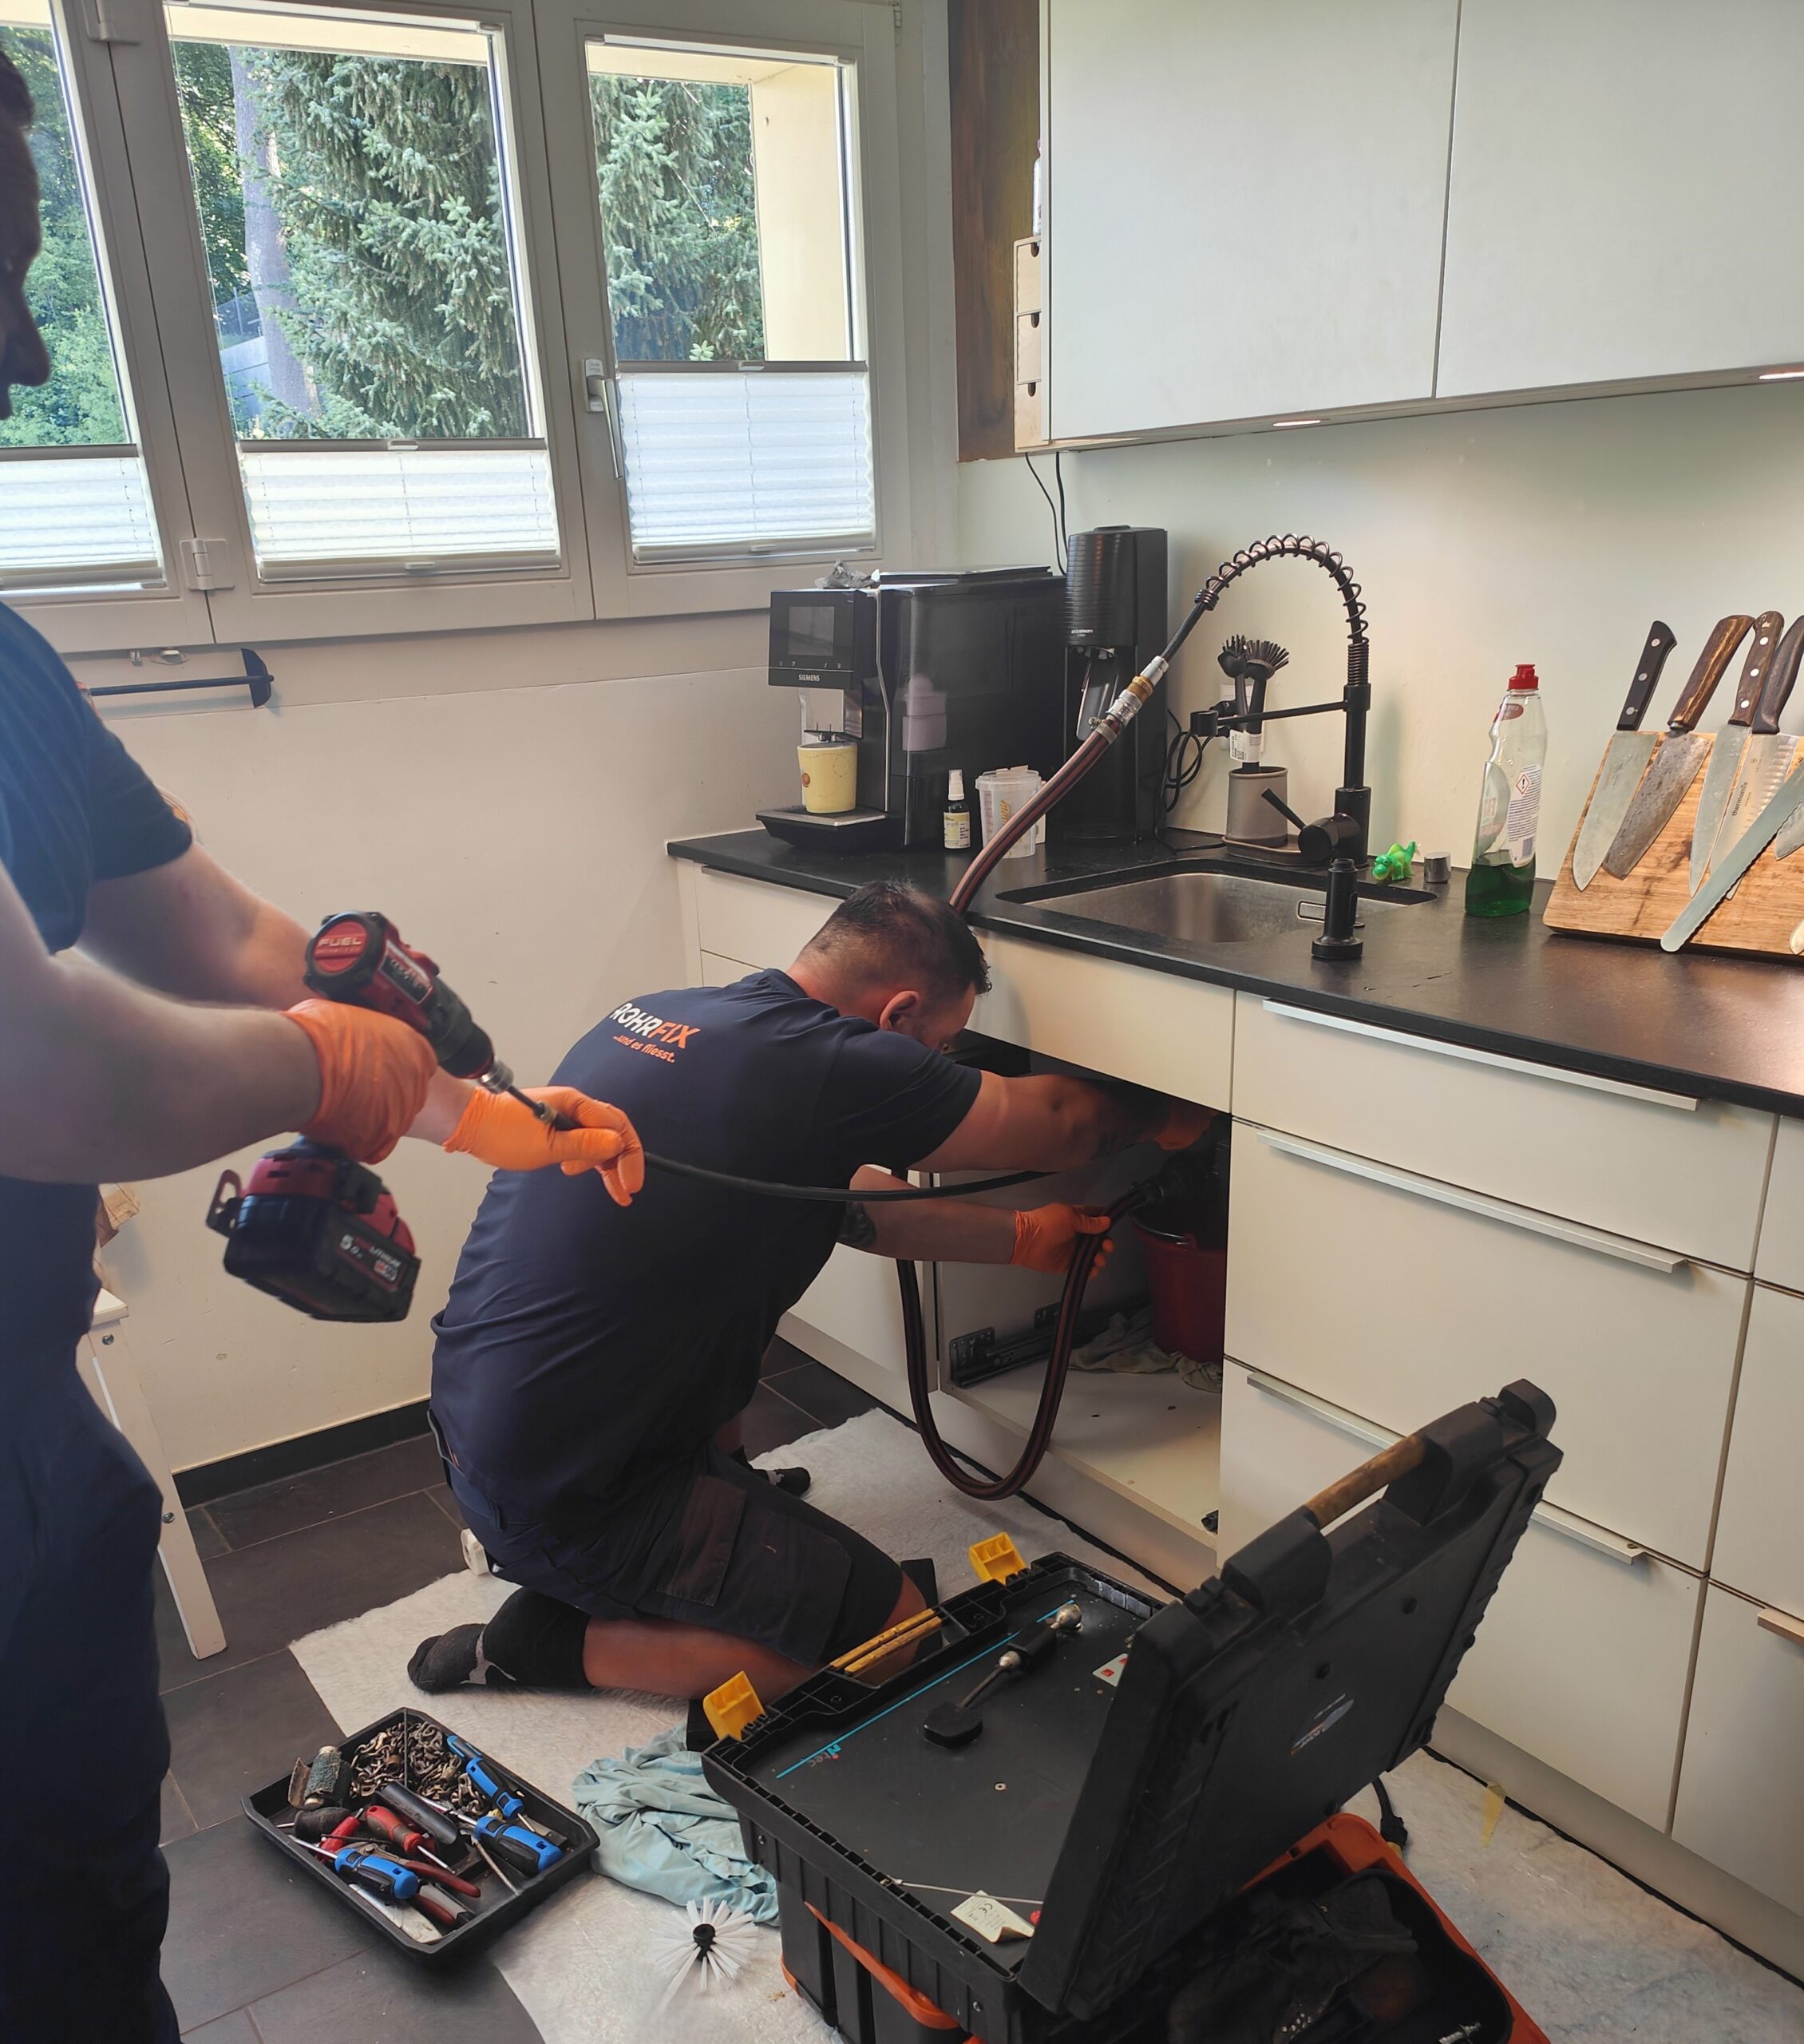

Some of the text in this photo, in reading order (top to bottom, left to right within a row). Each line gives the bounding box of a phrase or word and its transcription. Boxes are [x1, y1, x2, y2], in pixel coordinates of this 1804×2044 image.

[1731, 782, 1748, 816] thermomix
[318, 937, 362, 947] FUEL
[609, 1002, 701, 1049] ROHRFIX
[631, 1041, 644, 1051] es
